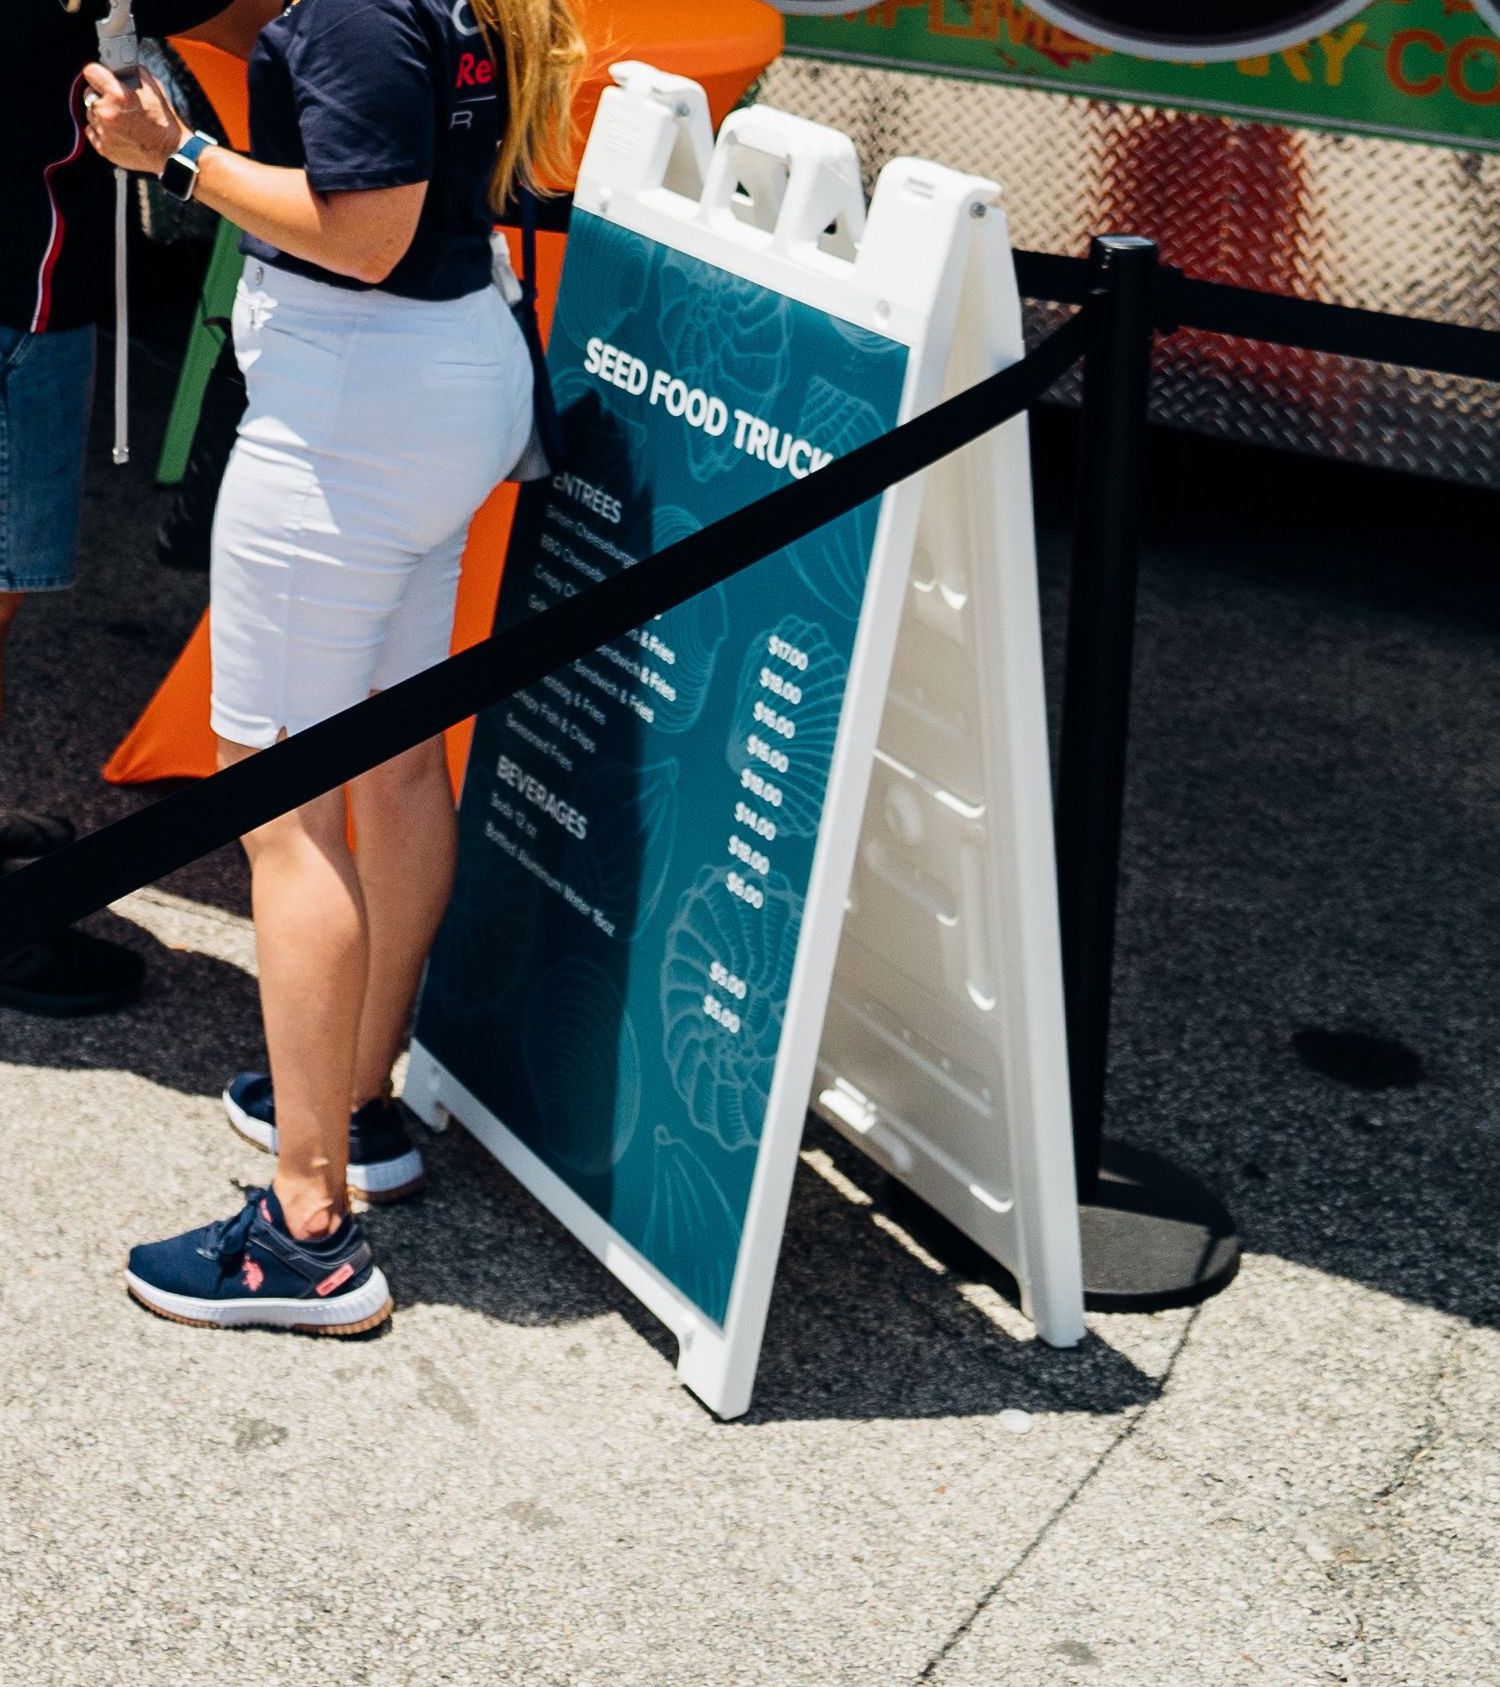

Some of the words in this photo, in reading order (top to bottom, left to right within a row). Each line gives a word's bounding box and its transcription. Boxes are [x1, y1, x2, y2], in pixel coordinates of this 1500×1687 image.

[456, 53, 496, 89] Re
[582, 336, 648, 396] SEED
[648, 369, 728, 436] FOOD
[646, 634, 675, 664] Fries
[646, 671, 676, 702] Fries
[496, 754, 588, 840] BEVERAGES
